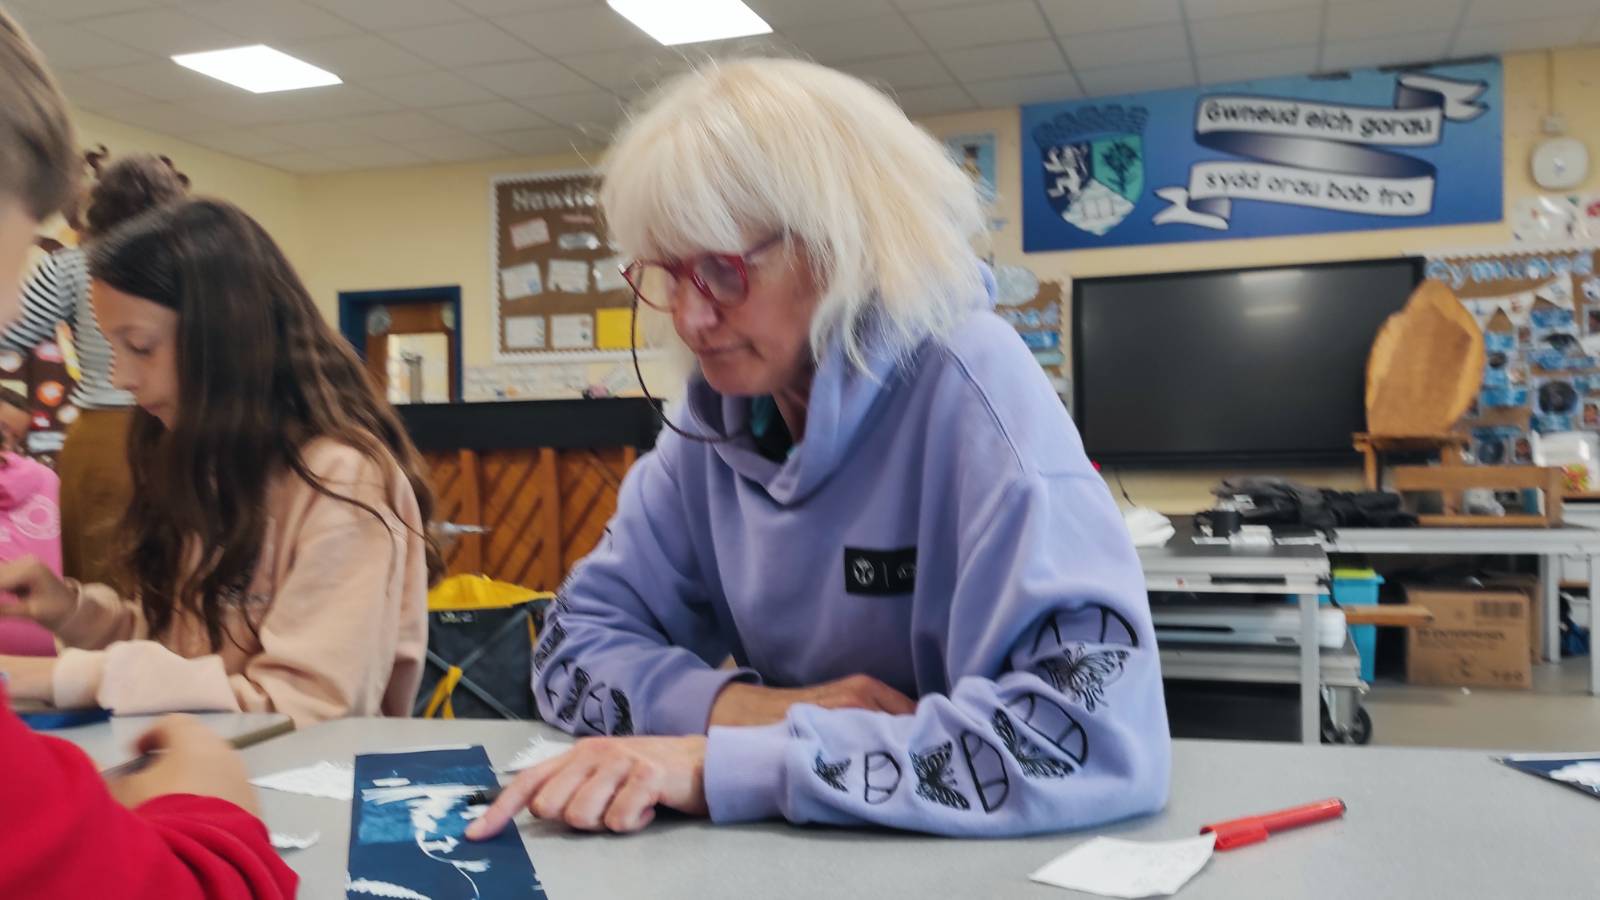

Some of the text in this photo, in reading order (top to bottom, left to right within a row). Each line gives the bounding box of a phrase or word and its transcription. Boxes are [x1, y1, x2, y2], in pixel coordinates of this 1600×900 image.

[1205, 99, 1432, 137] Gwneud eich gorau
[1205, 170, 1414, 207] sydd orau bob tro
